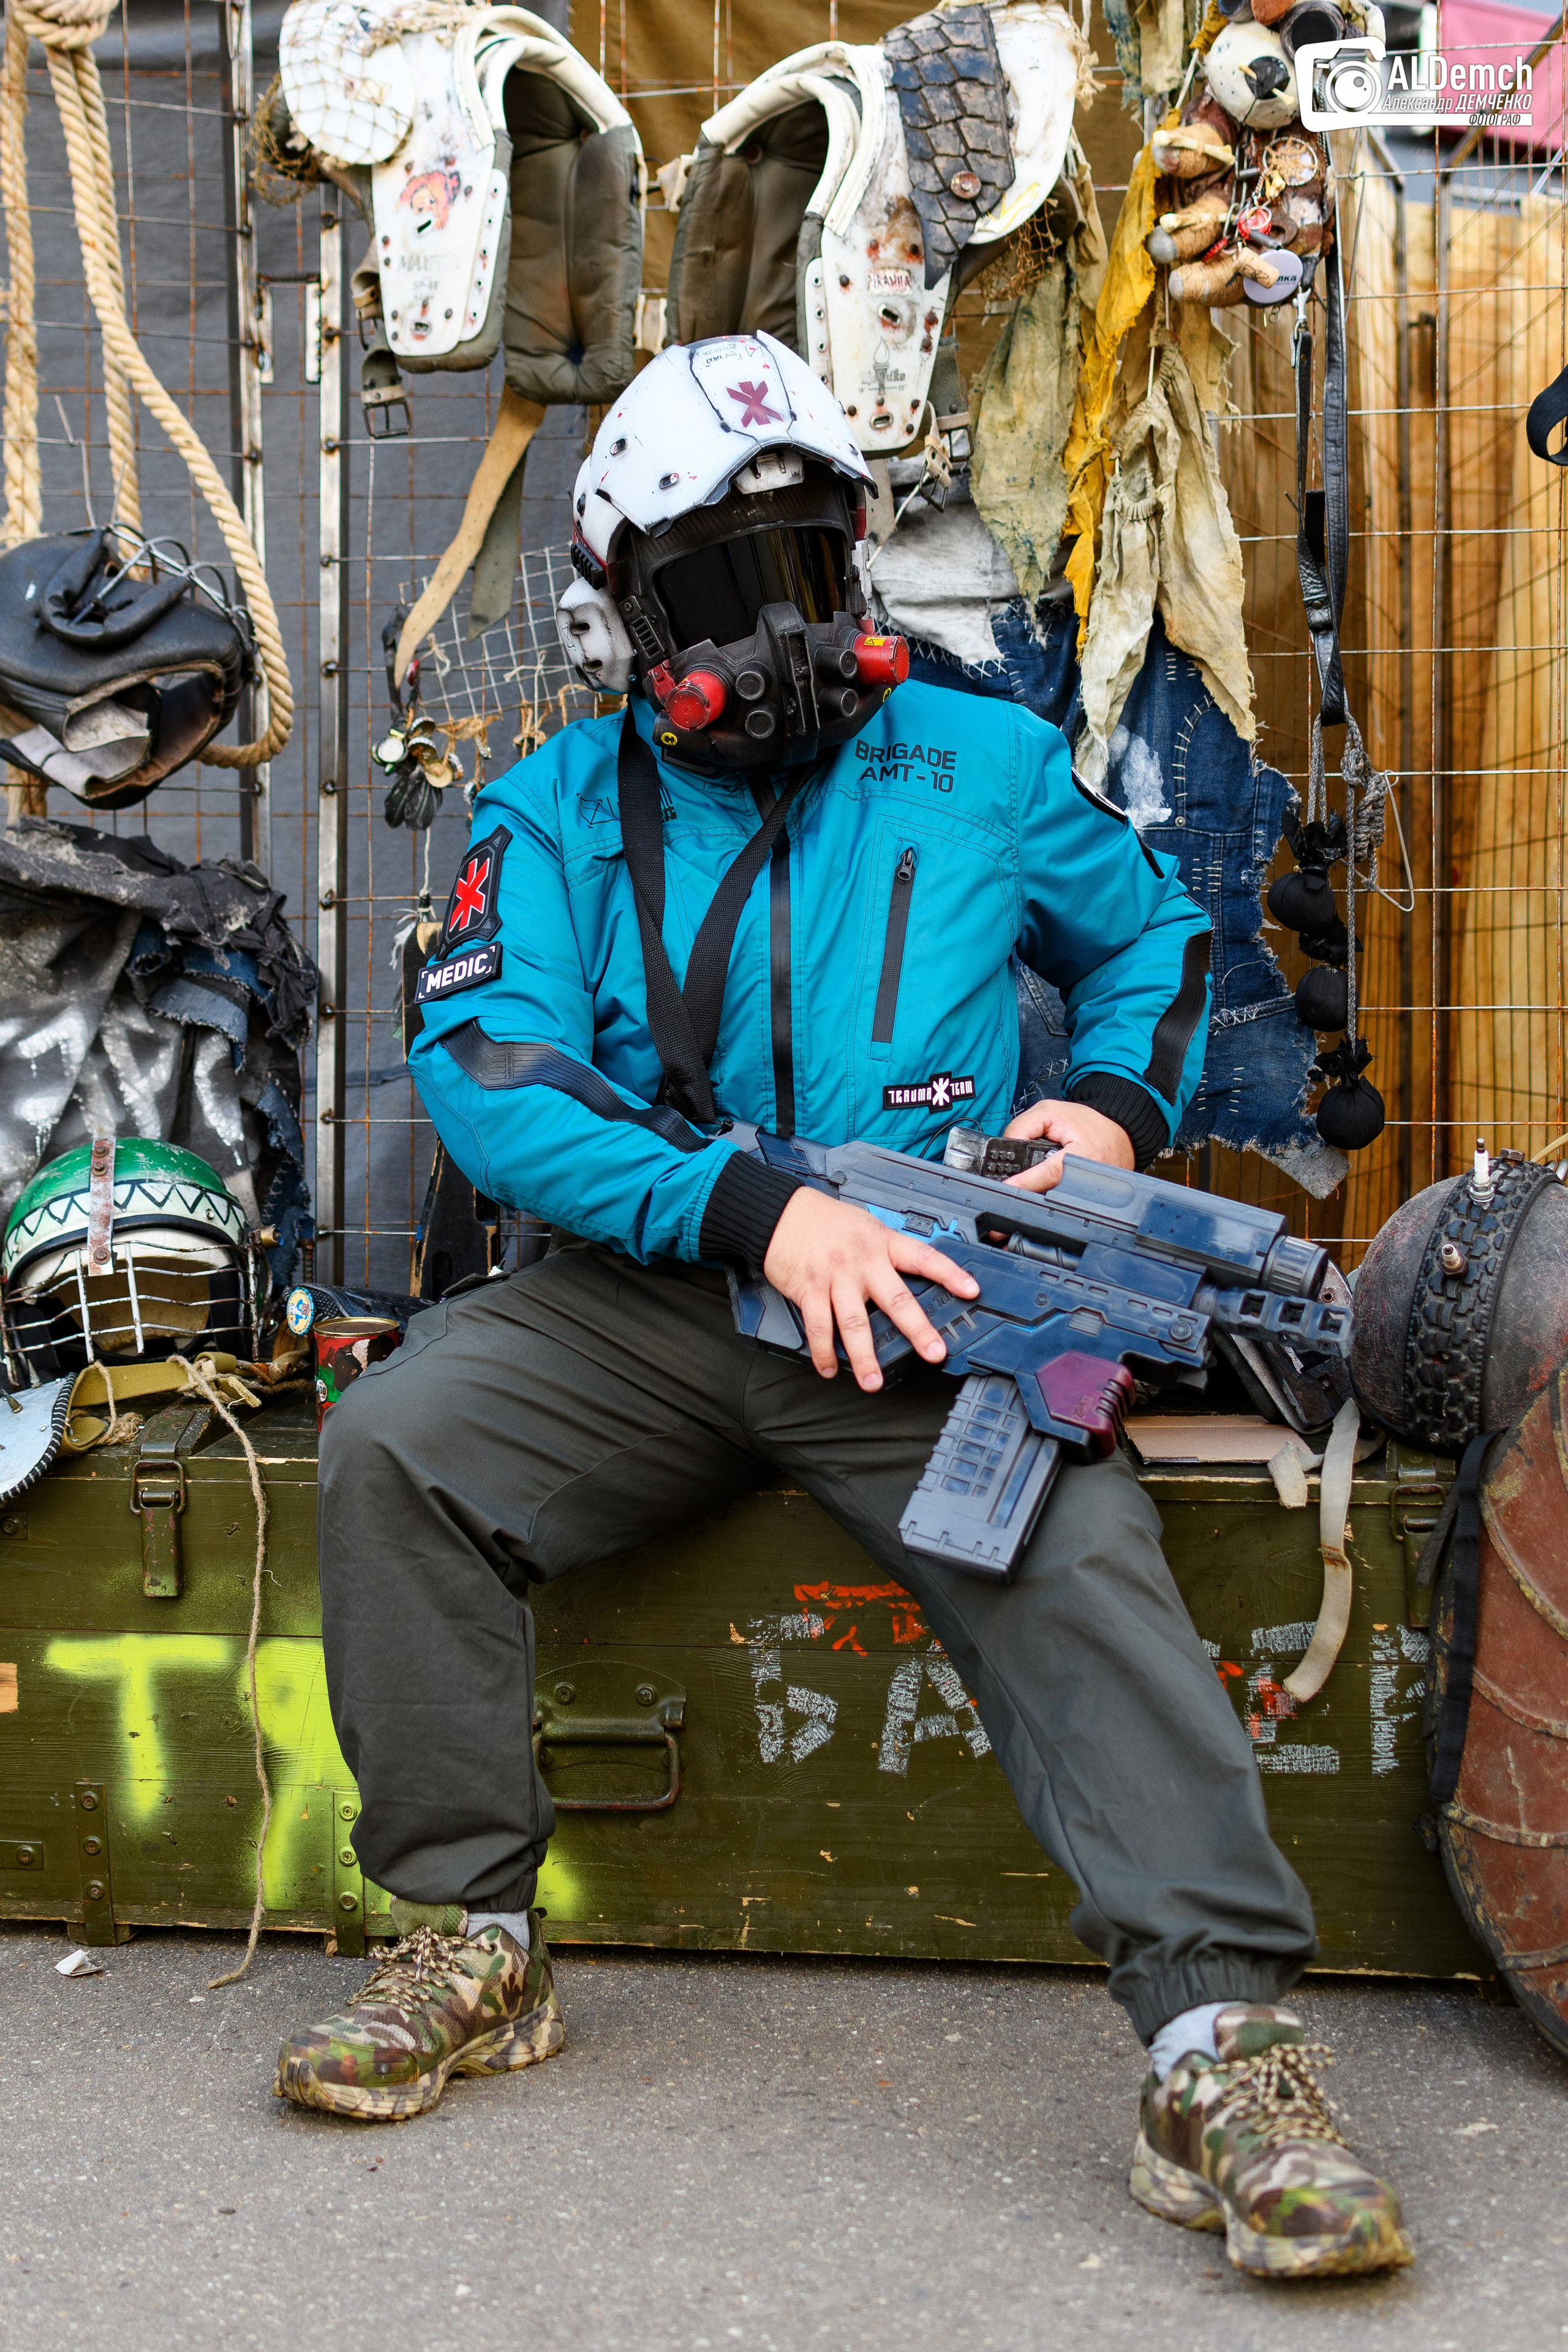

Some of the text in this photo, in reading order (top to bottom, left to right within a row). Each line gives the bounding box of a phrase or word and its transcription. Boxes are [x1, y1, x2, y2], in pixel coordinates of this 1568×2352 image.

[855, 739, 957, 770] BRIGADE
[426, 953, 488, 993] MEDIC
[888, 1080, 973, 1104] TRAUMA TEAM
